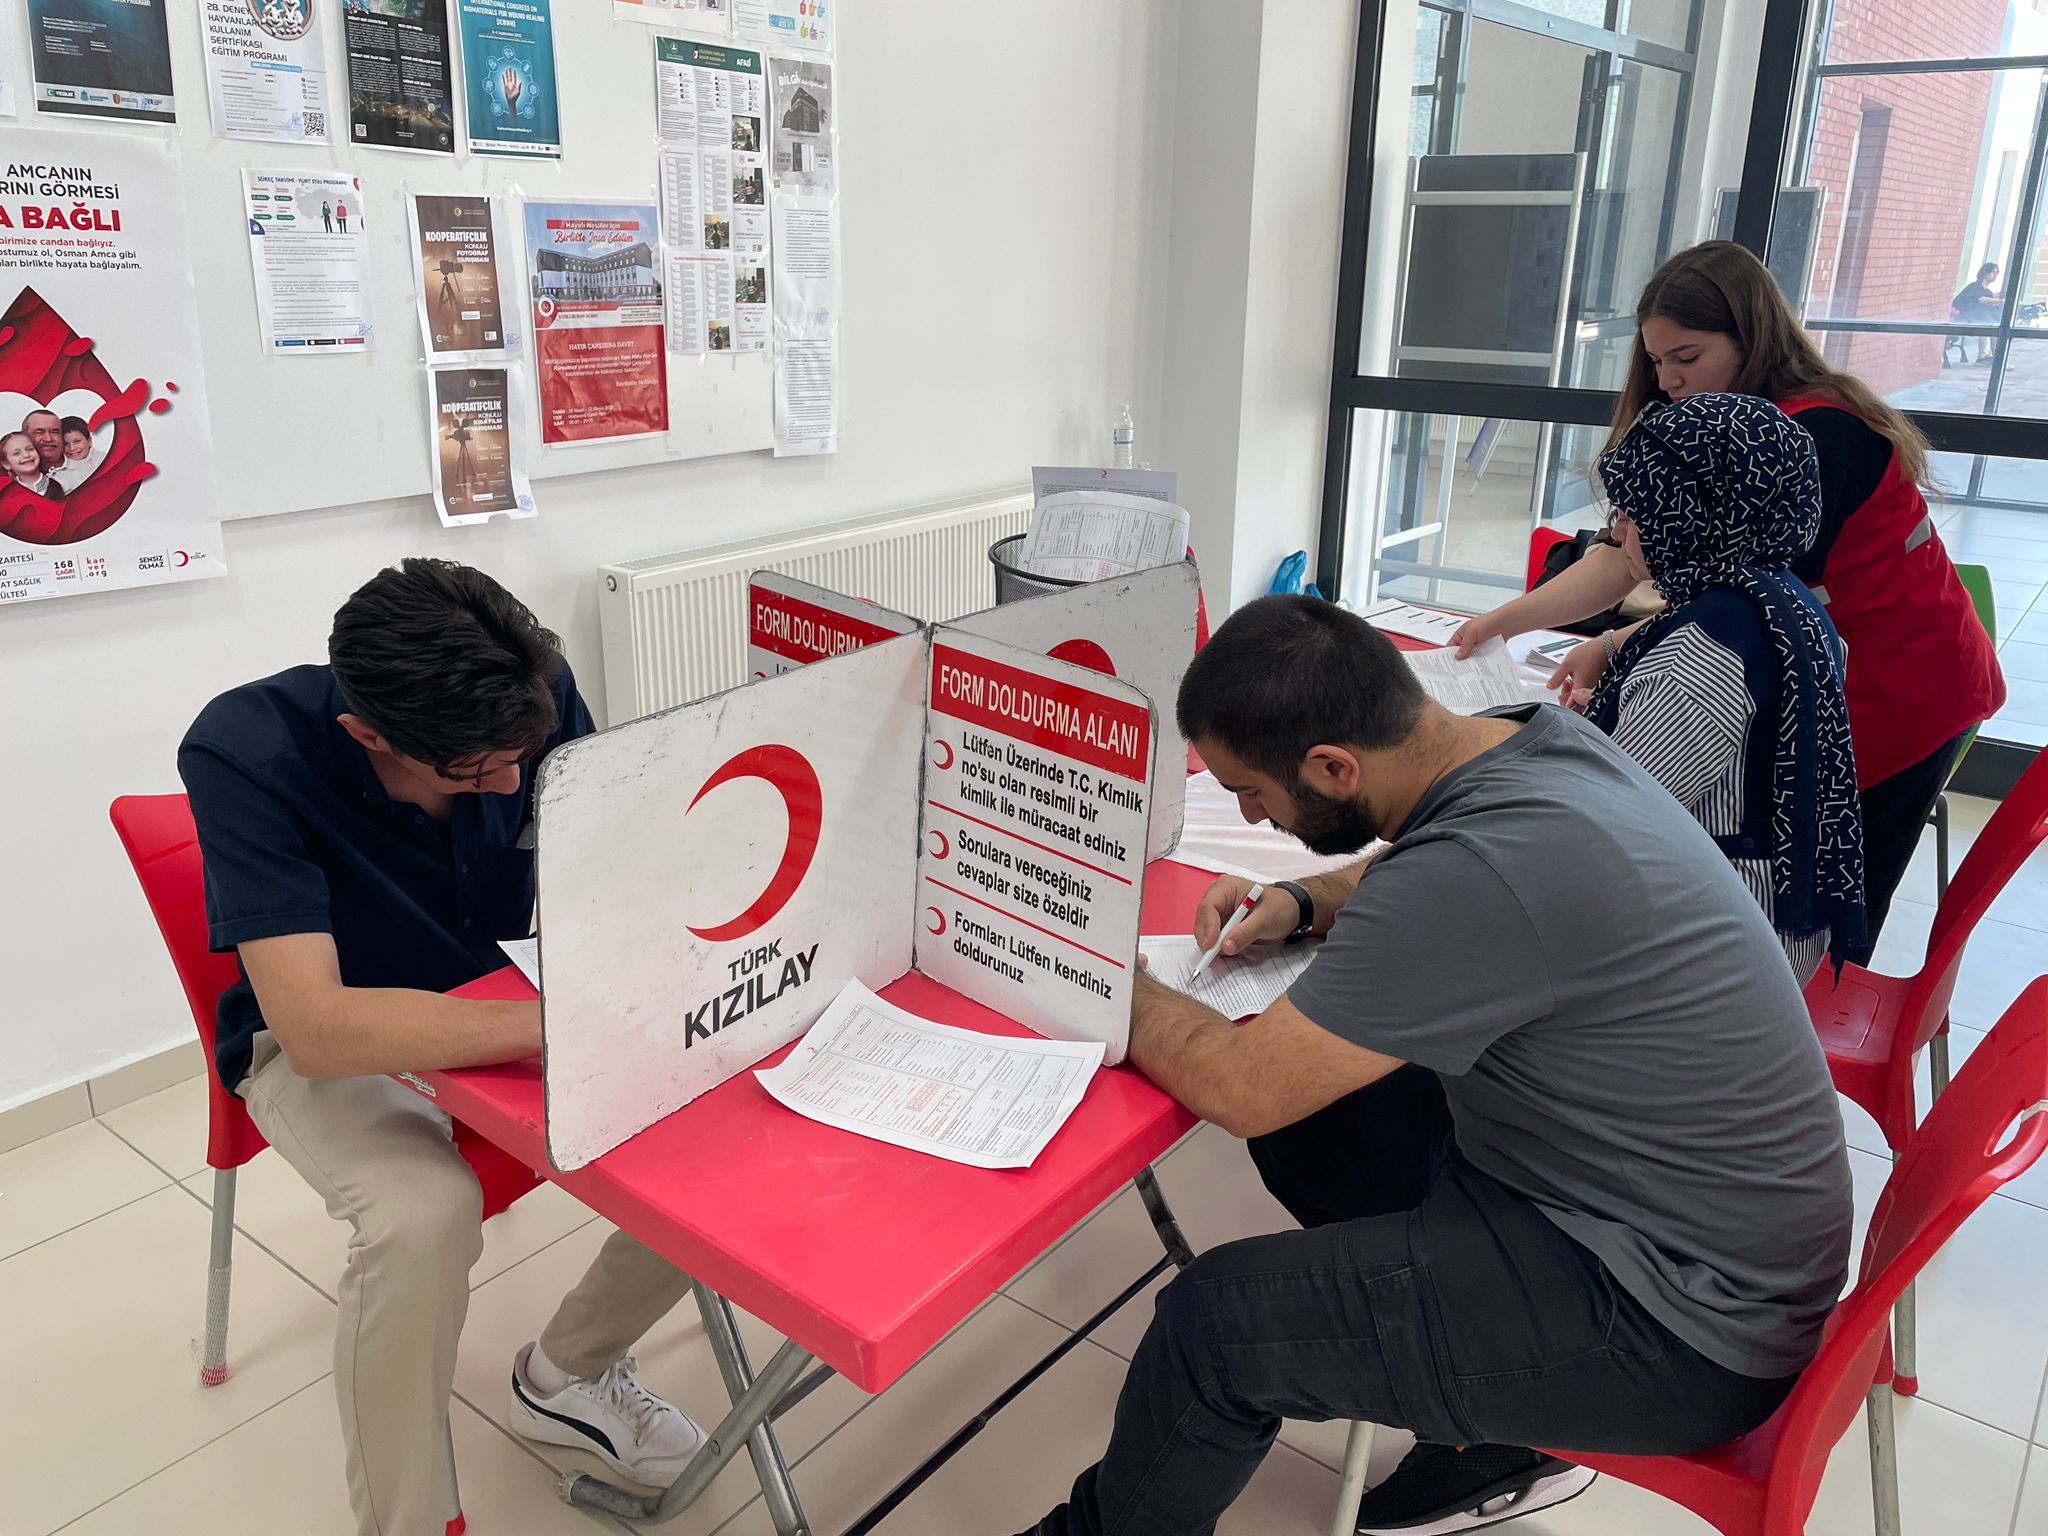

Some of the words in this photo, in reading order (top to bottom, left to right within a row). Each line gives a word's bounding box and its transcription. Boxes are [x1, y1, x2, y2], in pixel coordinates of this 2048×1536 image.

[210, 25, 251, 36] KULLANIM
[211, 36, 262, 48] SERTİFİKASI
[212, 47, 240, 56] EĞİTİM
[244, 51, 287, 62] PROGRAMI
[7, 164, 92, 181] AMCANIN
[40, 180, 120, 199] GÖRMESİ
[21, 202, 121, 232] BAĞLI
[40, 238, 74, 246] candan
[77, 239, 115, 248] bağlıyız.
[41, 249, 52, 257] ol,
[119, 251, 136, 259] gibi
[56, 261, 87, 269] hayata
[90, 260, 142, 270] bağlayalım.
[54, 560, 73, 569] 168
[139, 562, 164, 570] OLMAZ
[14, 578, 41, 587] SAĞLIK
[756, 604, 790, 641] FORM
[941, 665, 984, 708] FORM
[988, 679, 1080, 740] DOLDURMA
[1084, 710, 1139, 760] ALANI
[962, 732, 1002, 762] Lütfen
[1006, 743, 1064, 784] Üzerinde
[1068, 768, 1093, 795] T.C.
[1098, 782, 1143, 813] Kimlik
[962, 759, 995, 784] no'su
[999, 772, 1027, 795] olan
[1030, 785, 1075, 815] resimli
[1079, 801, 1098, 823] bir
[960, 781, 997, 810] kimlik
[1001, 794, 1015, 815] ile
[1019, 804, 1081, 843] müracaat
[1084, 832, 1126, 862] ediniz
[958, 829, 1011, 868] Sorulara
[1015, 856, 1092, 902] vereceğiniz
[957, 860, 1011, 897] cevaplar
[1013, 884, 1039, 908] size
[1042, 894, 1089, 930] özeldir
[728, 937, 782, 981] TÜRK
[953, 937, 1024, 984] doldurunuz
[954, 910, 1006, 950] Formları
[1009, 934, 1051, 967] Lütfen
[1054, 959, 1112, 1000] kendiniz
[685, 943, 819, 1049] KIZILAY
